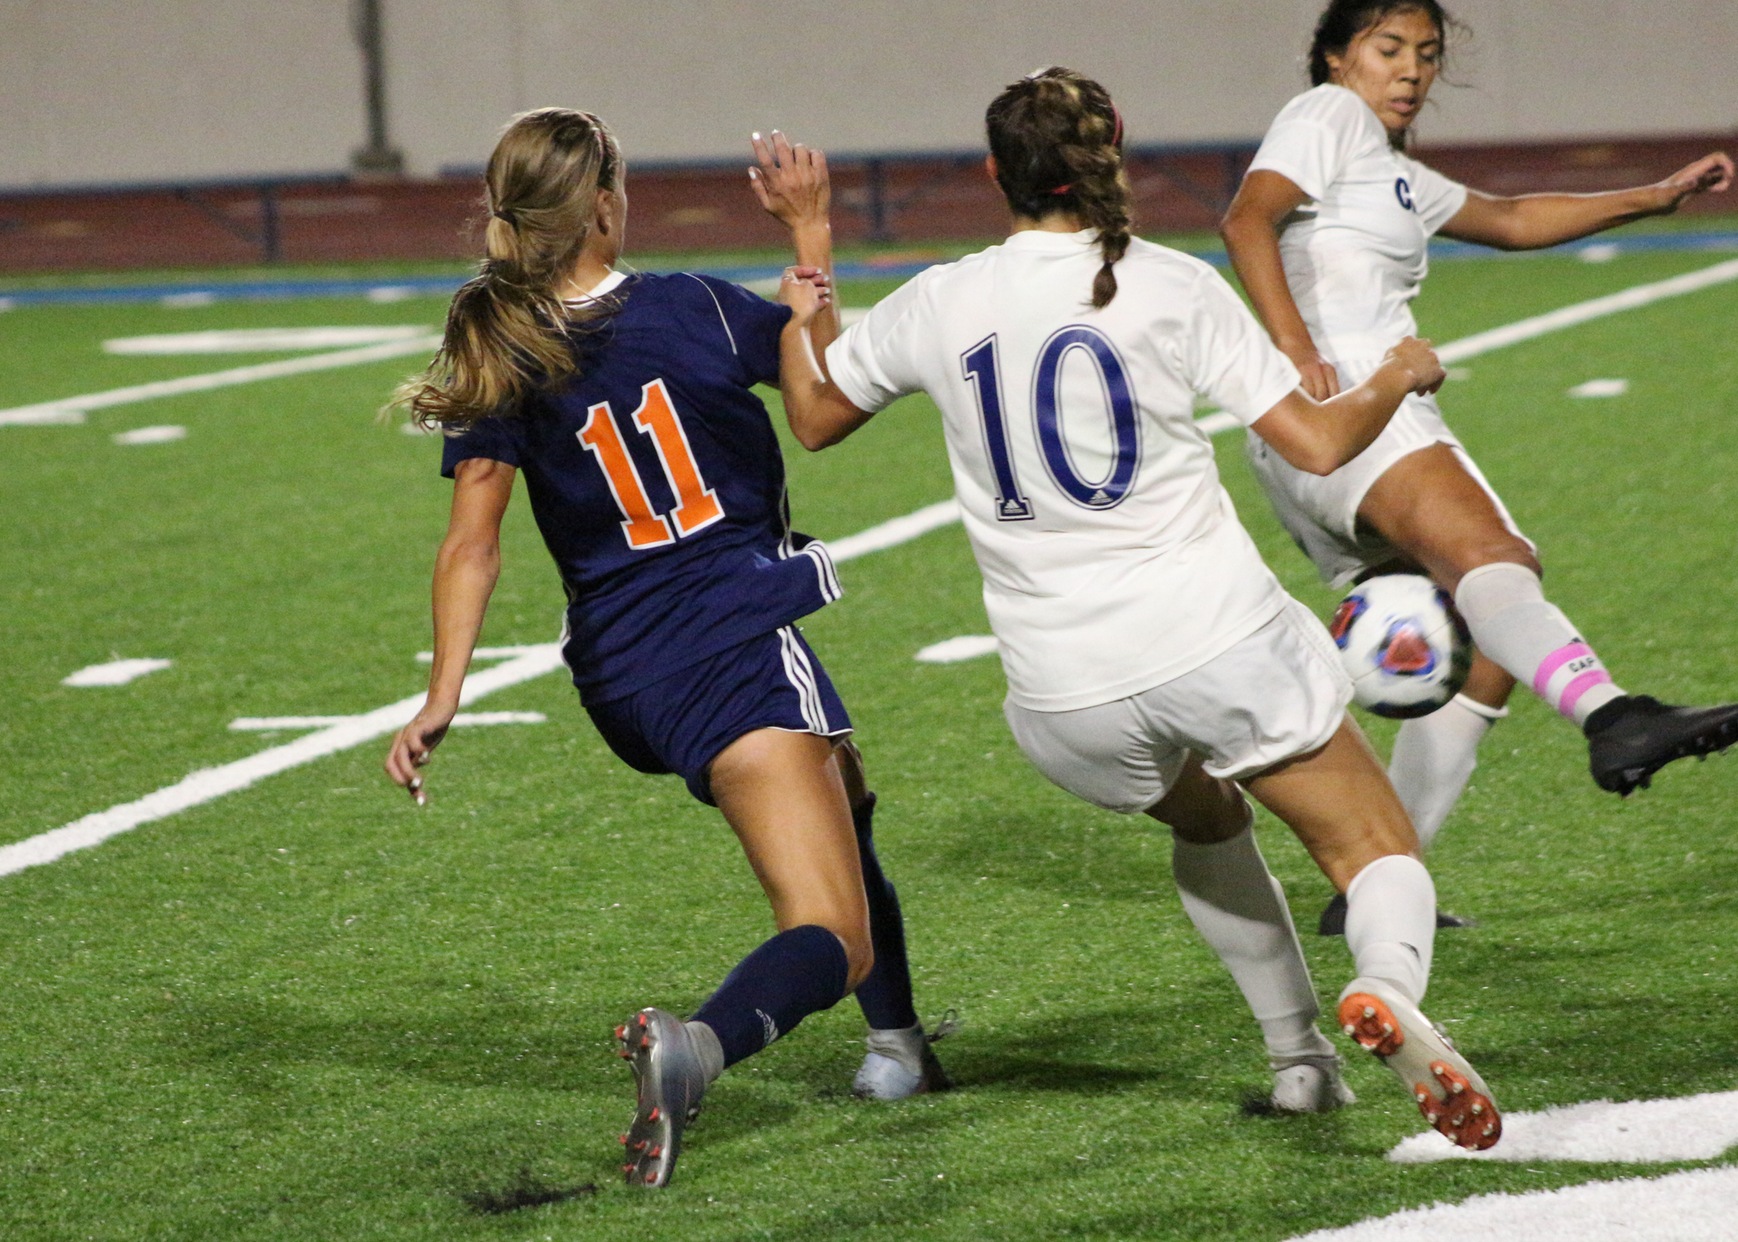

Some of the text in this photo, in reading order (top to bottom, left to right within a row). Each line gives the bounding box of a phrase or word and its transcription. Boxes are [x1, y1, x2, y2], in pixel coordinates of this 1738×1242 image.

[1395, 177, 1417, 213] C
[575, 377, 726, 551] 11
[960, 324, 1143, 521] 10
